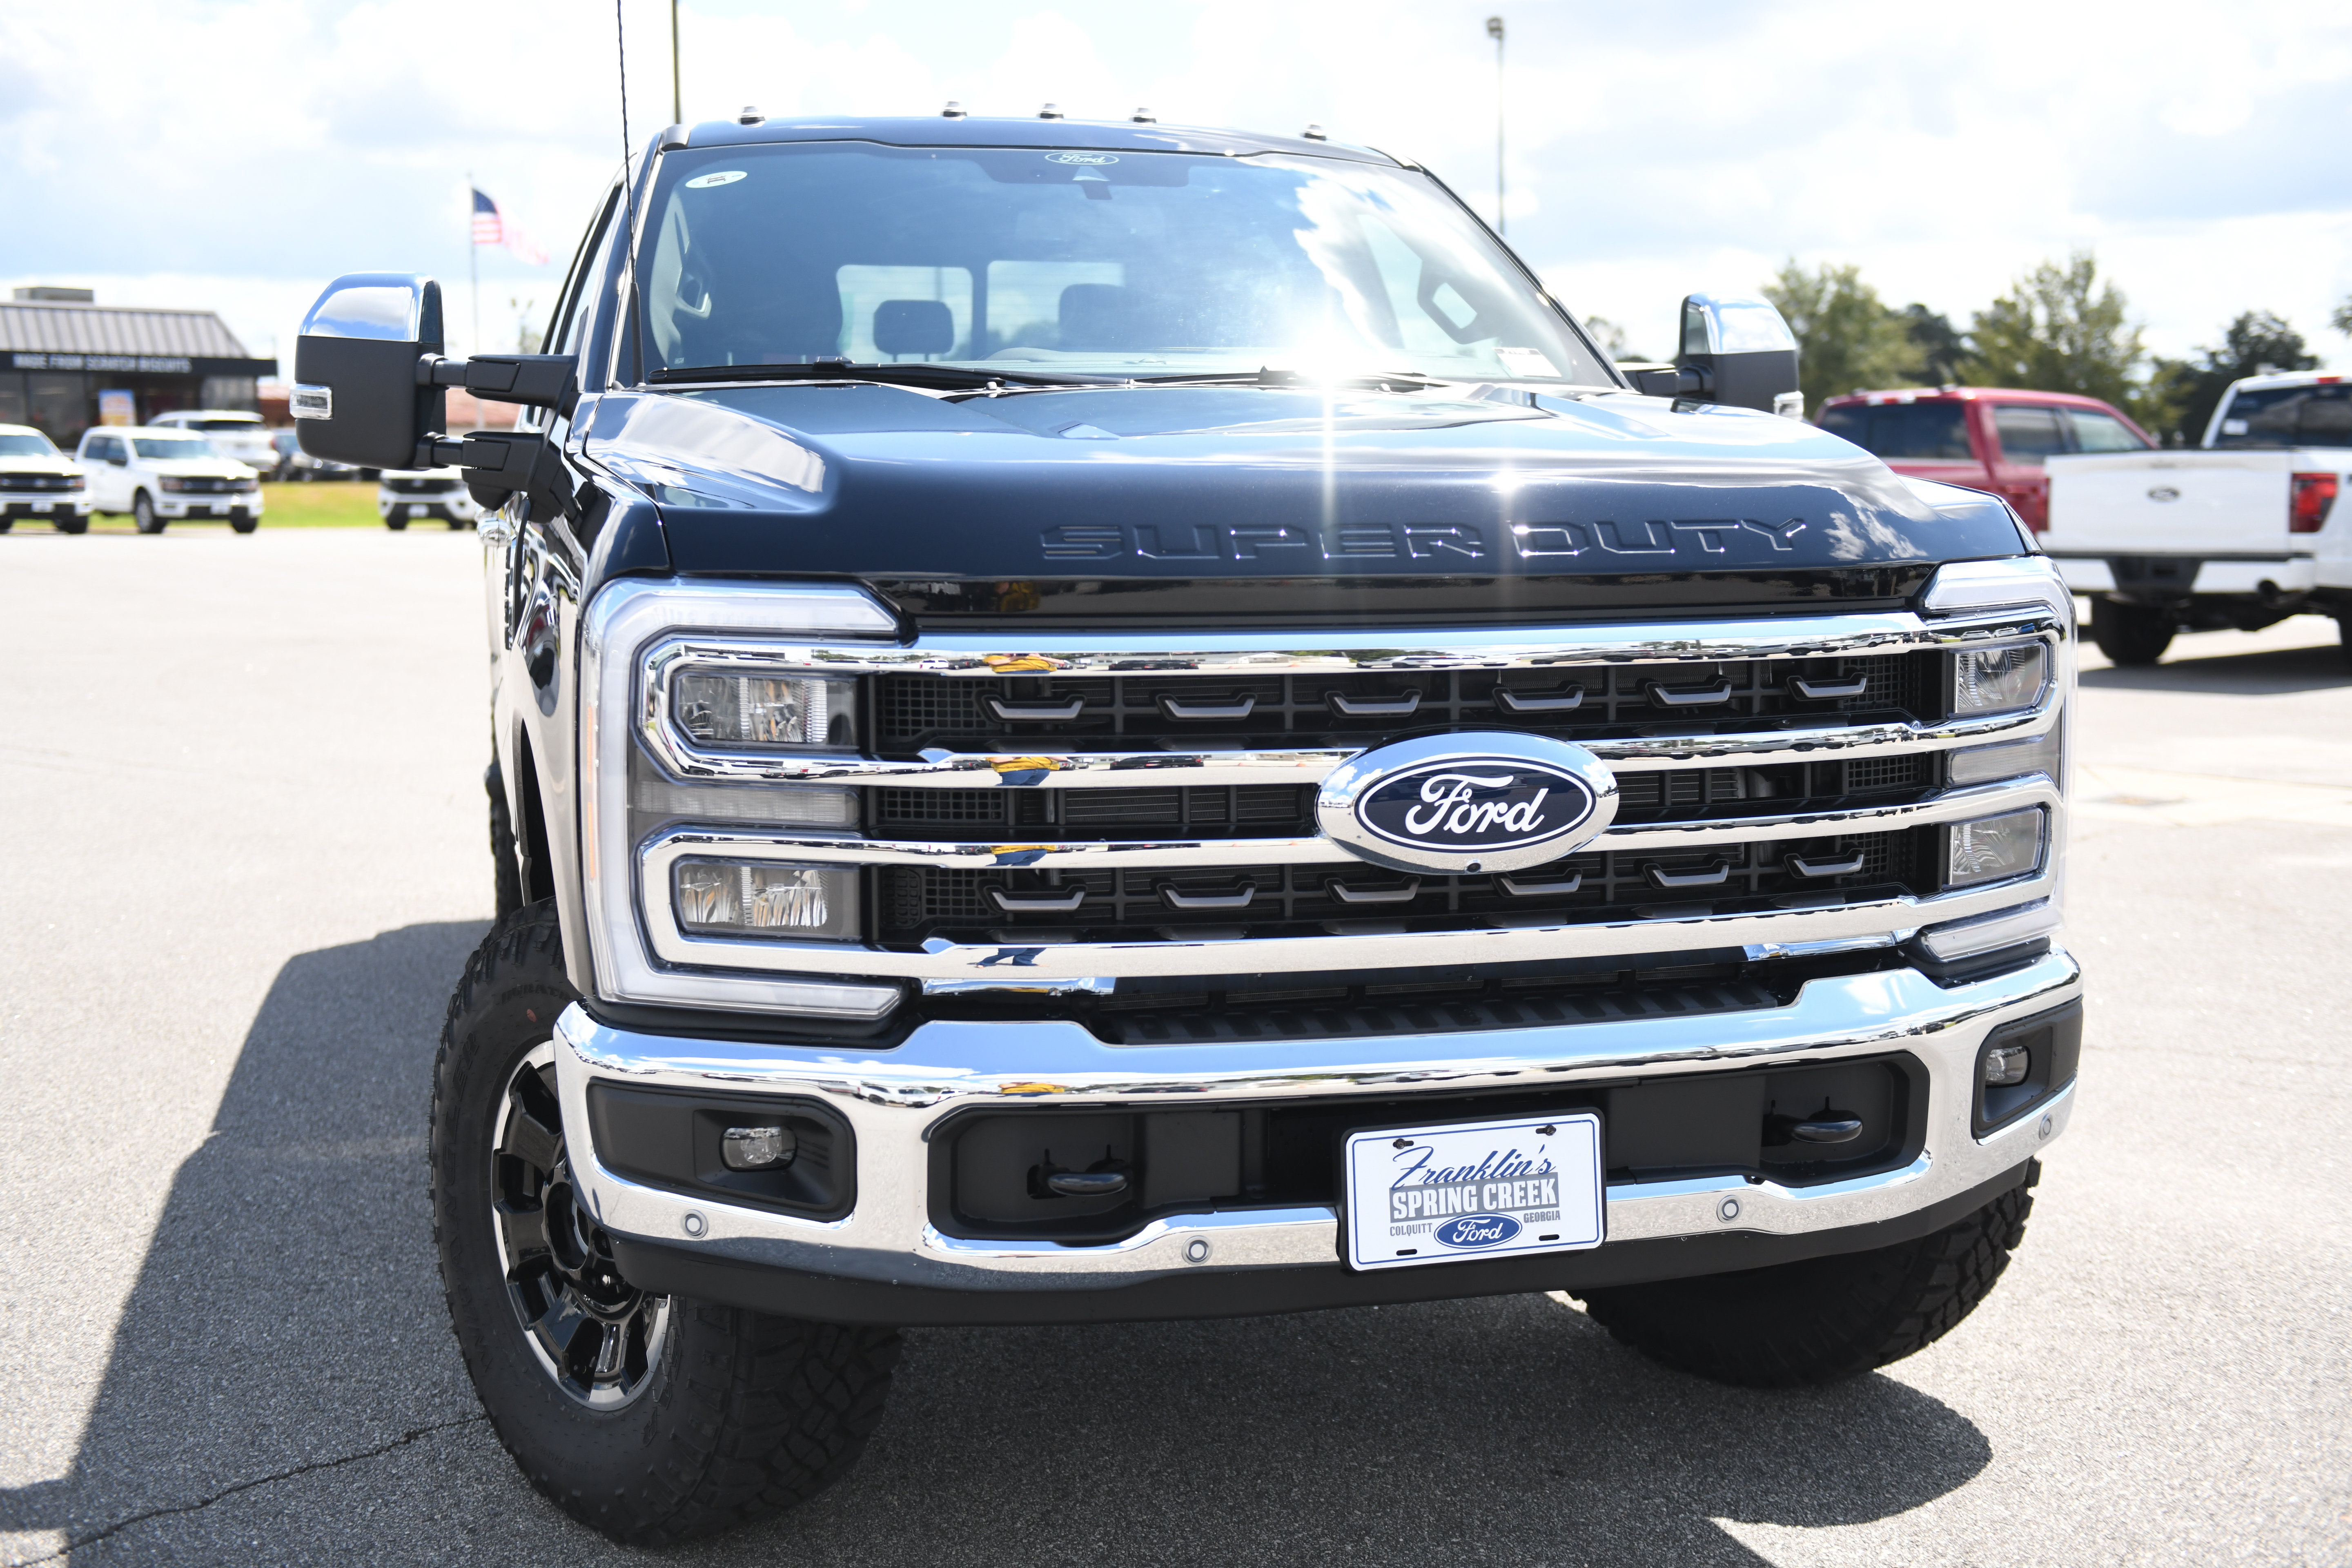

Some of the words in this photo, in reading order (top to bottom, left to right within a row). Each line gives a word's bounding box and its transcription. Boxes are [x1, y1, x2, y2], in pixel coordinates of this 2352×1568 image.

[1058, 154, 1106, 163] Ford
[1038, 521, 1485, 562] SUPER
[1508, 516, 1807, 557] DUTY
[1405, 773, 1548, 835] Ford
[1391, 1144, 1557, 1190] Franklin's
[1392, 1185, 1478, 1219] SPRING
[1483, 1178, 1557, 1214] CREEK
[1390, 1222, 1432, 1236] COLQUITT
[1452, 1218, 1503, 1243] Ford
[1523, 1210, 1561, 1223] GEORGIA
